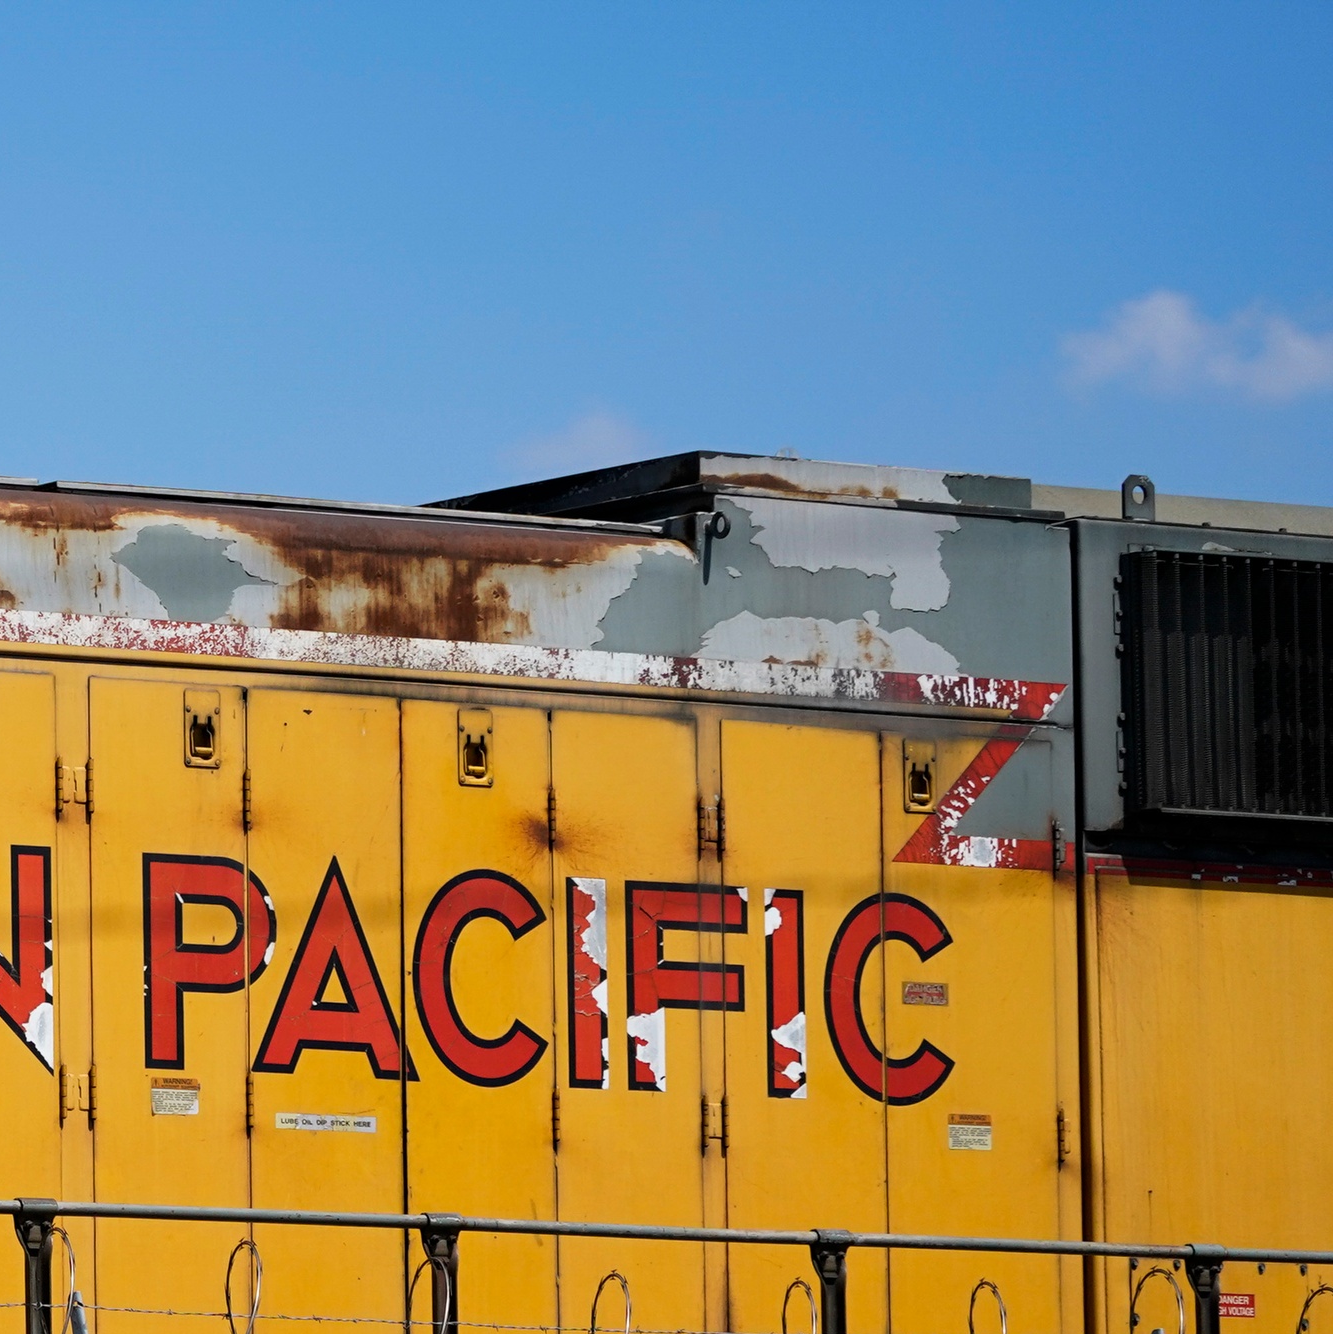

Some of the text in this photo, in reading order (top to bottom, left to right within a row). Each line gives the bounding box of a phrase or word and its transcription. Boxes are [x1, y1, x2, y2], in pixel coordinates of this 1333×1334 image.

[143, 853, 955, 1106] PACIFIC
[353, 1120, 371, 1128] HERE
[1228, 1307, 1254, 1316] VOLTAGE
